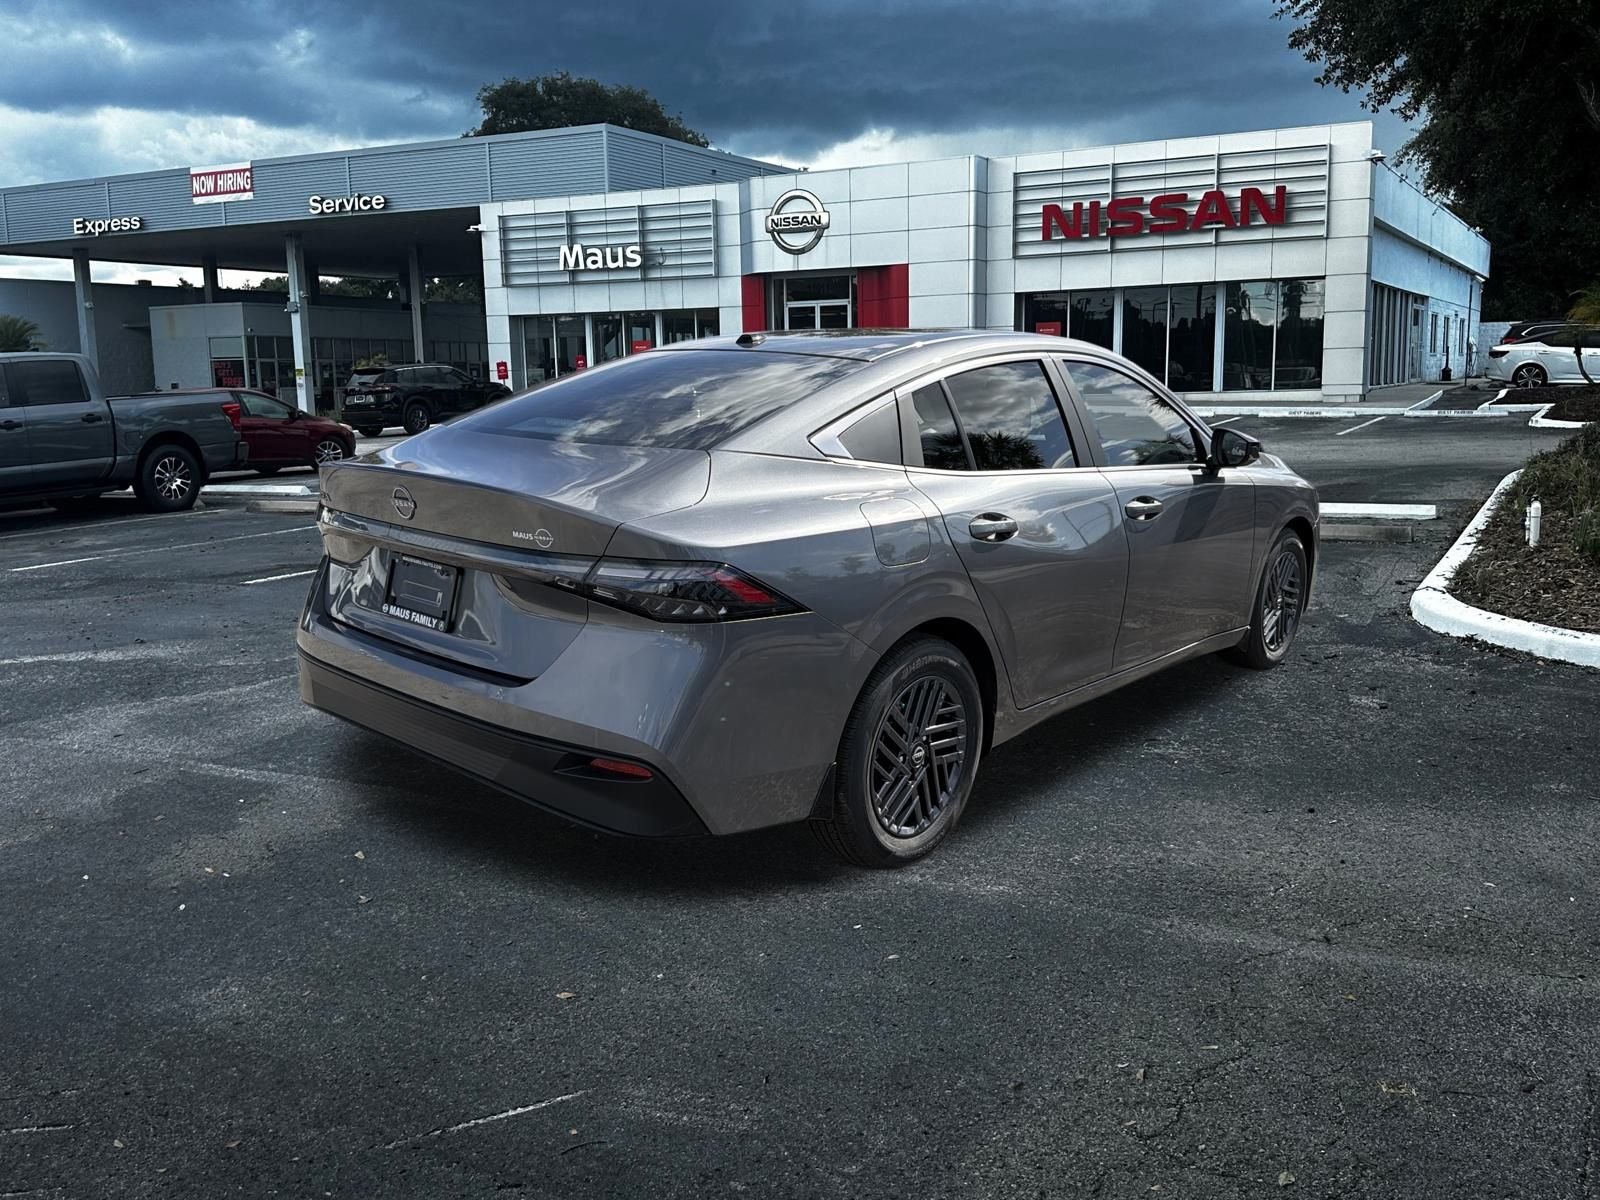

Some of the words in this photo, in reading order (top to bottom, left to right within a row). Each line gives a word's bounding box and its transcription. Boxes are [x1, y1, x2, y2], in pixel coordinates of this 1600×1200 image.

[192, 175, 215, 195] NOW
[217, 170, 252, 192] HIRING
[308, 193, 386, 214] Service
[1041, 185, 1287, 241] NISSAN
[72, 215, 142, 236] Express
[769, 214, 822, 230] NISSAN
[558, 243, 642, 271] Maus
[512, 530, 533, 541] MAUS
[389, 604, 411, 620] MAUS
[410, 611, 438, 629] FAMILY
